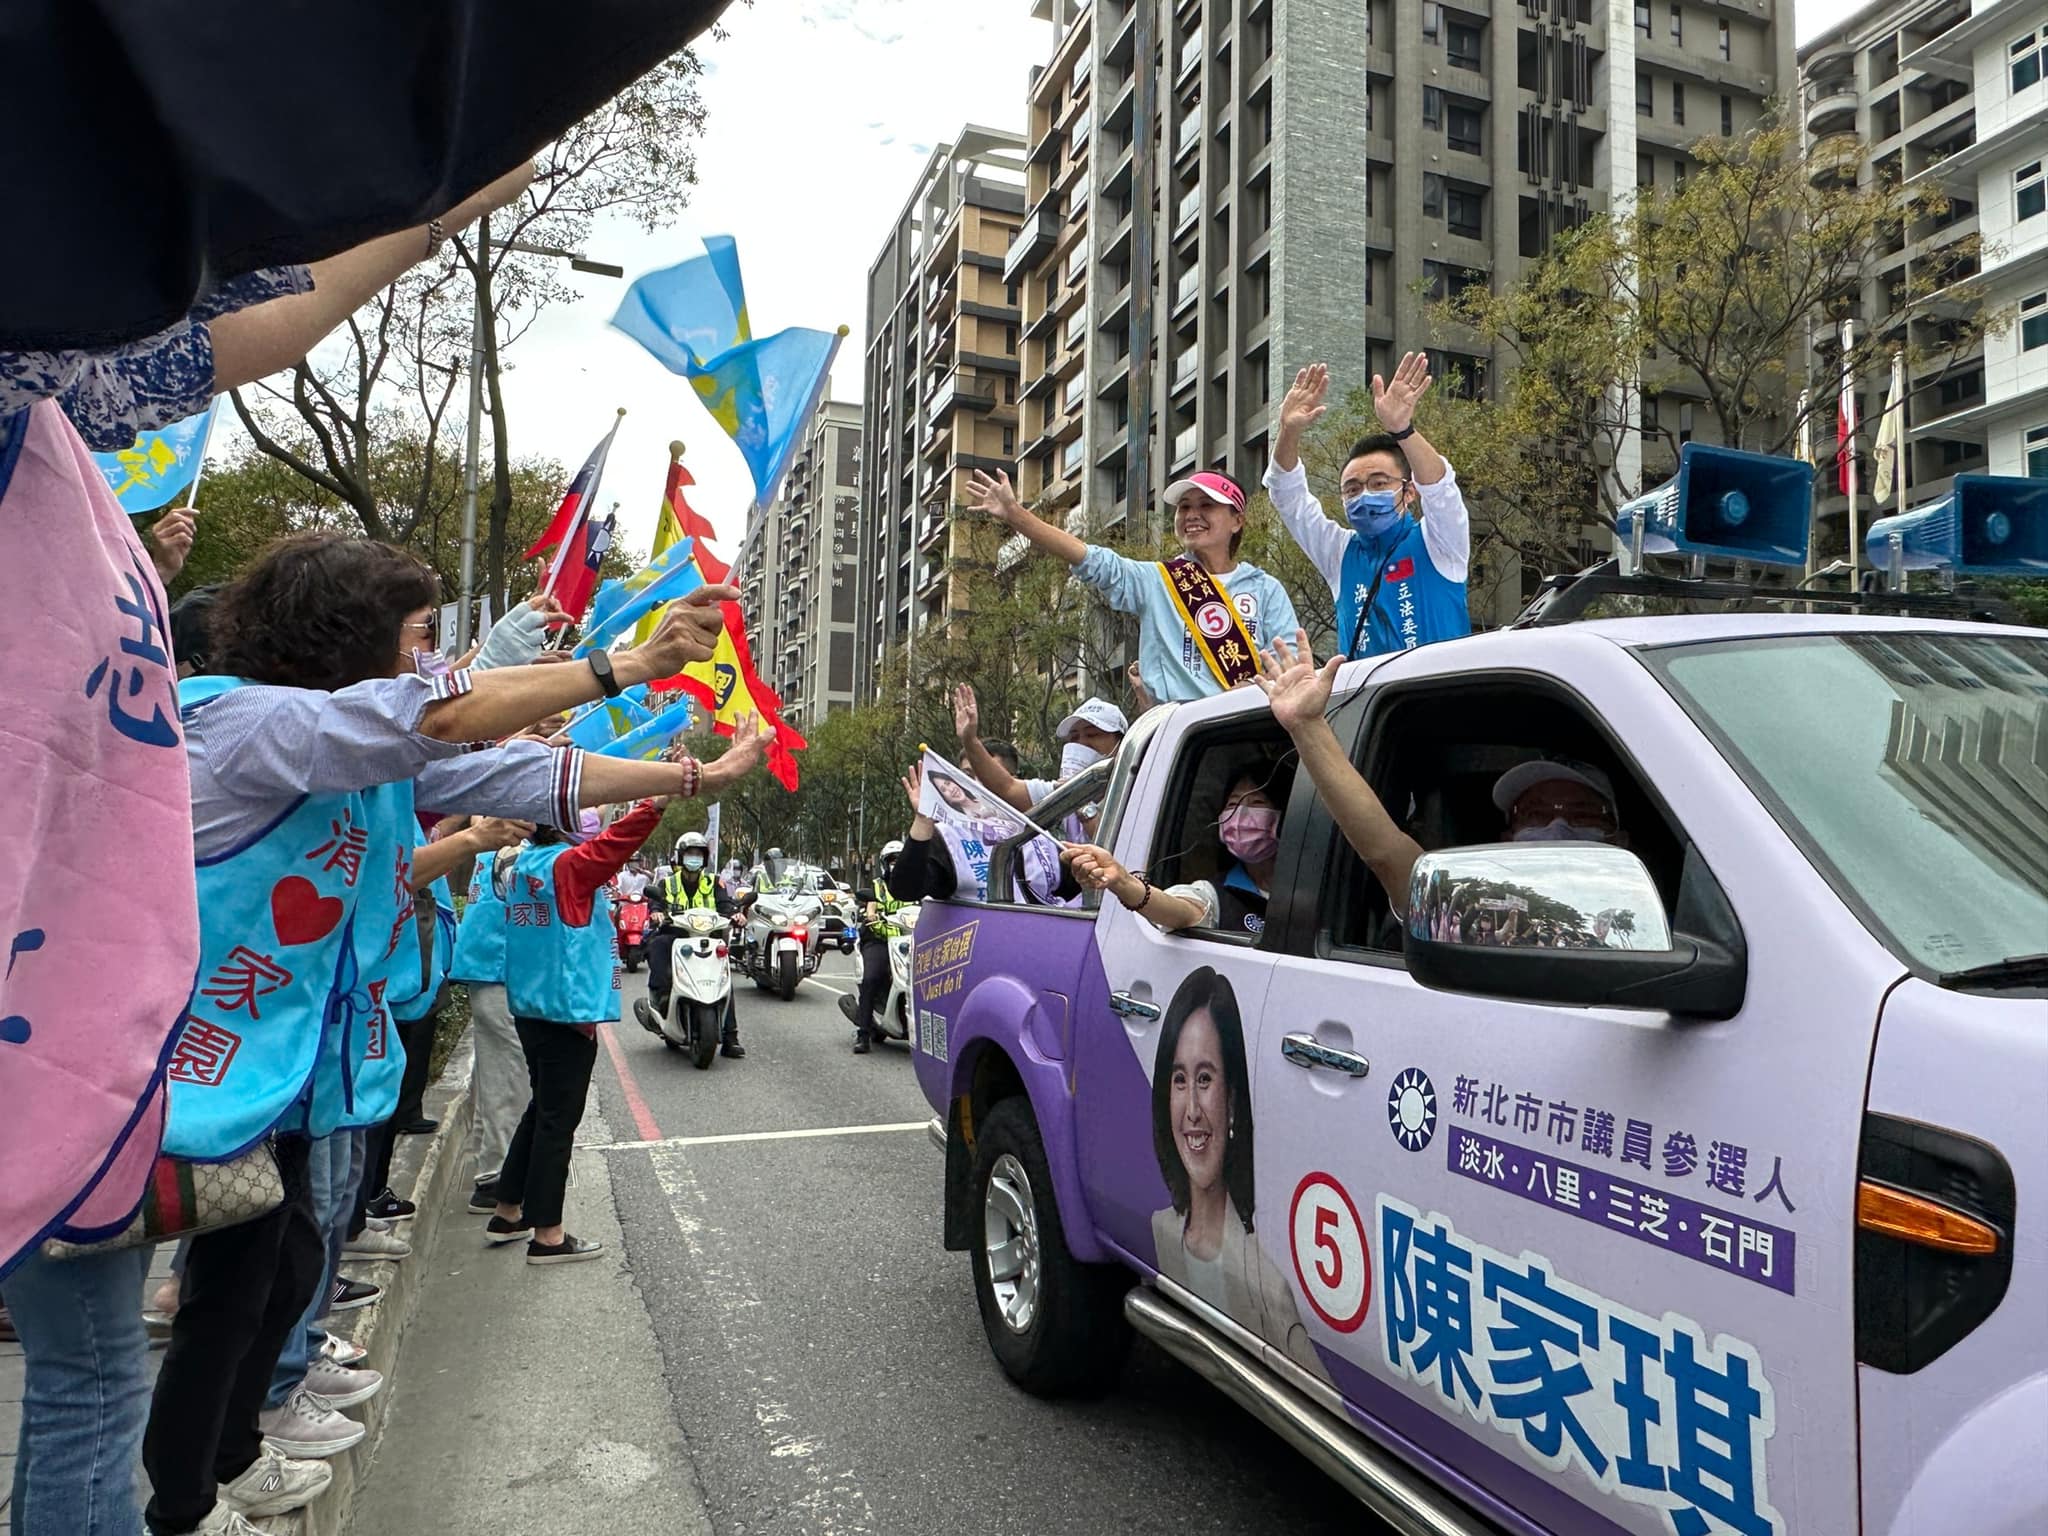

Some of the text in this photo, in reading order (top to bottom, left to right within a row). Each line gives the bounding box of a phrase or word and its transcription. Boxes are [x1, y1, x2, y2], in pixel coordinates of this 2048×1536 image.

[1240, 598, 1251, 614] 5
[1204, 608, 1225, 633] 5
[513, 902, 550, 927] 家園
[926, 978, 943, 1001] Just
[944, 974, 954, 994] do
[1453, 1074, 1796, 1213] 新北市市議員參選人
[1313, 1206, 1342, 1290] 5
[1381, 1203, 1775, 1536] 陳家琪
